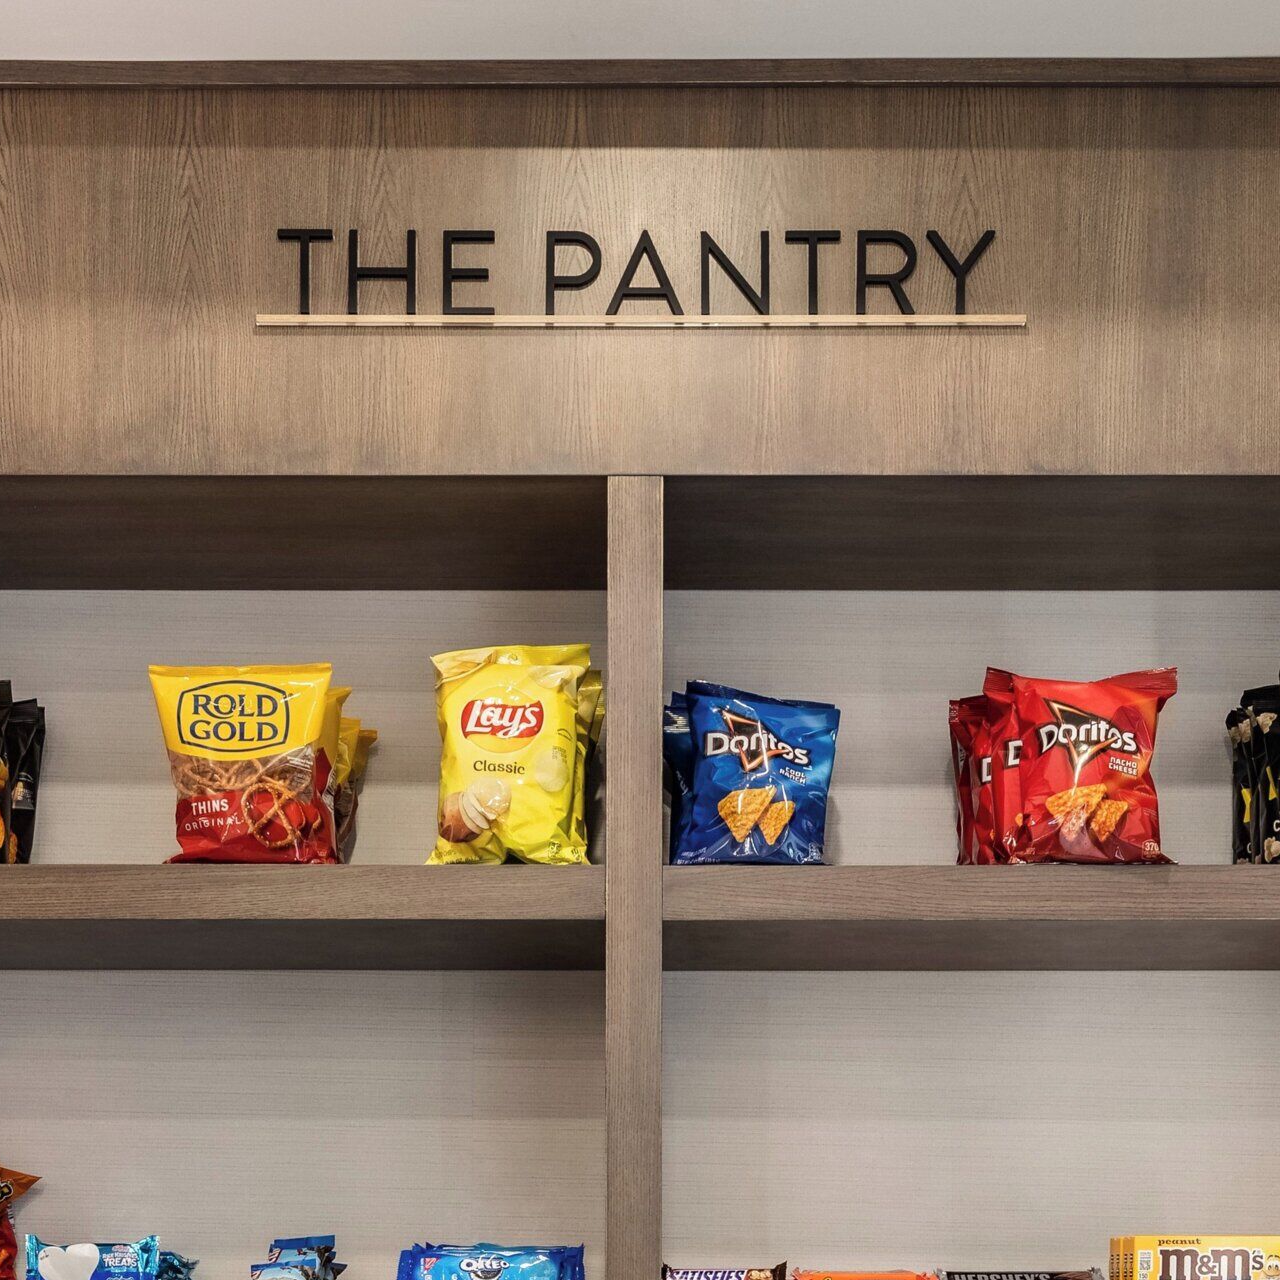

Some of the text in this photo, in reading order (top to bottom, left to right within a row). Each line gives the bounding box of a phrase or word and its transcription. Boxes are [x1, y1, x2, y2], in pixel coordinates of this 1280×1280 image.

[276, 228, 997, 316] THE PANTRY
[192, 694, 278, 718] ROLD
[466, 699, 540, 739] Lay's
[189, 720, 278, 742] GOLD
[1040, 721, 1137, 753] Doritos
[706, 730, 810, 766] Doritos
[473, 759, 525, 775] Classic
[1109, 762, 1138, 776] CHEESE
[1110, 757, 1137, 769] NACHO
[191, 798, 229, 815] THINS
[185, 814, 244, 831] ORIGINAL
[1158, 1238, 1202, 1246] peanut
[103, 1257, 137, 1267] TREATS
[1159, 1249, 1264, 1280] m&m's
